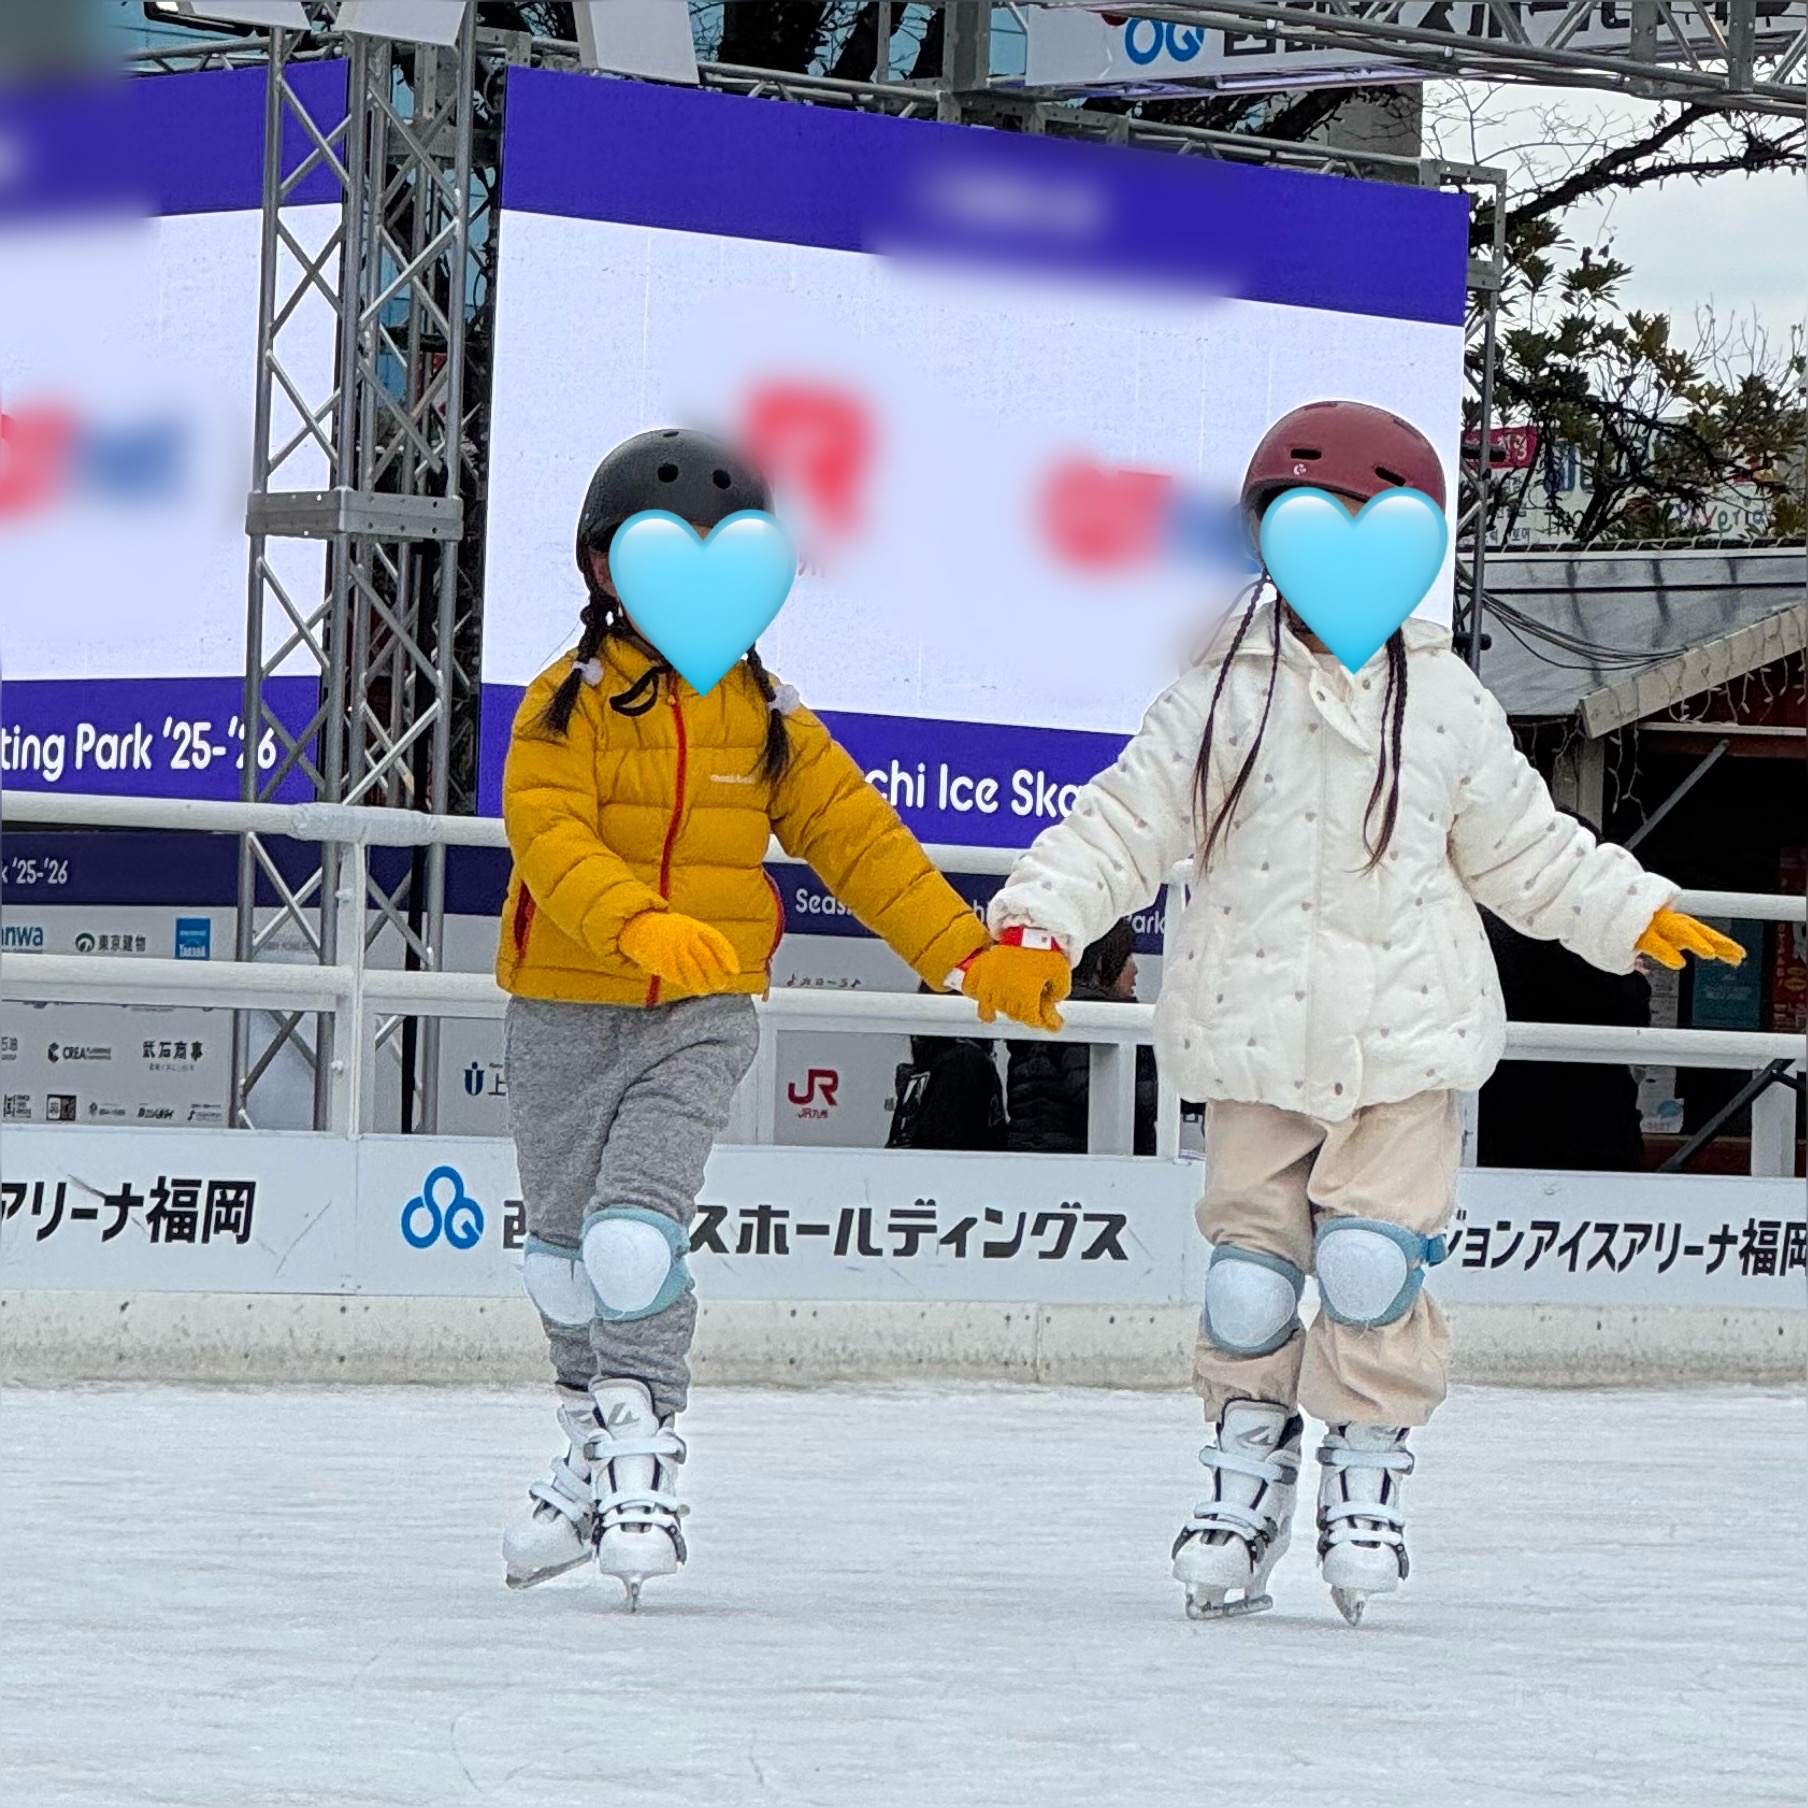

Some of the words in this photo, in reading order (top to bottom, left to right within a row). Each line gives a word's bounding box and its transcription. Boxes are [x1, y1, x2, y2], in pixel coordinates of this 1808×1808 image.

[2, 725, 65, 782] ting
[75, 722, 153, 770] Park
[938, 763, 998, 813] Ice
[12, 857, 68, 884] '25-'26
[796, 888, 853, 916] Seas
[2, 927, 43, 947] nwa
[1125, 911, 1165, 935] ark
[788, 1069, 838, 1106] JR
[2, 1176, 256, 1244] アリーナ福岡
